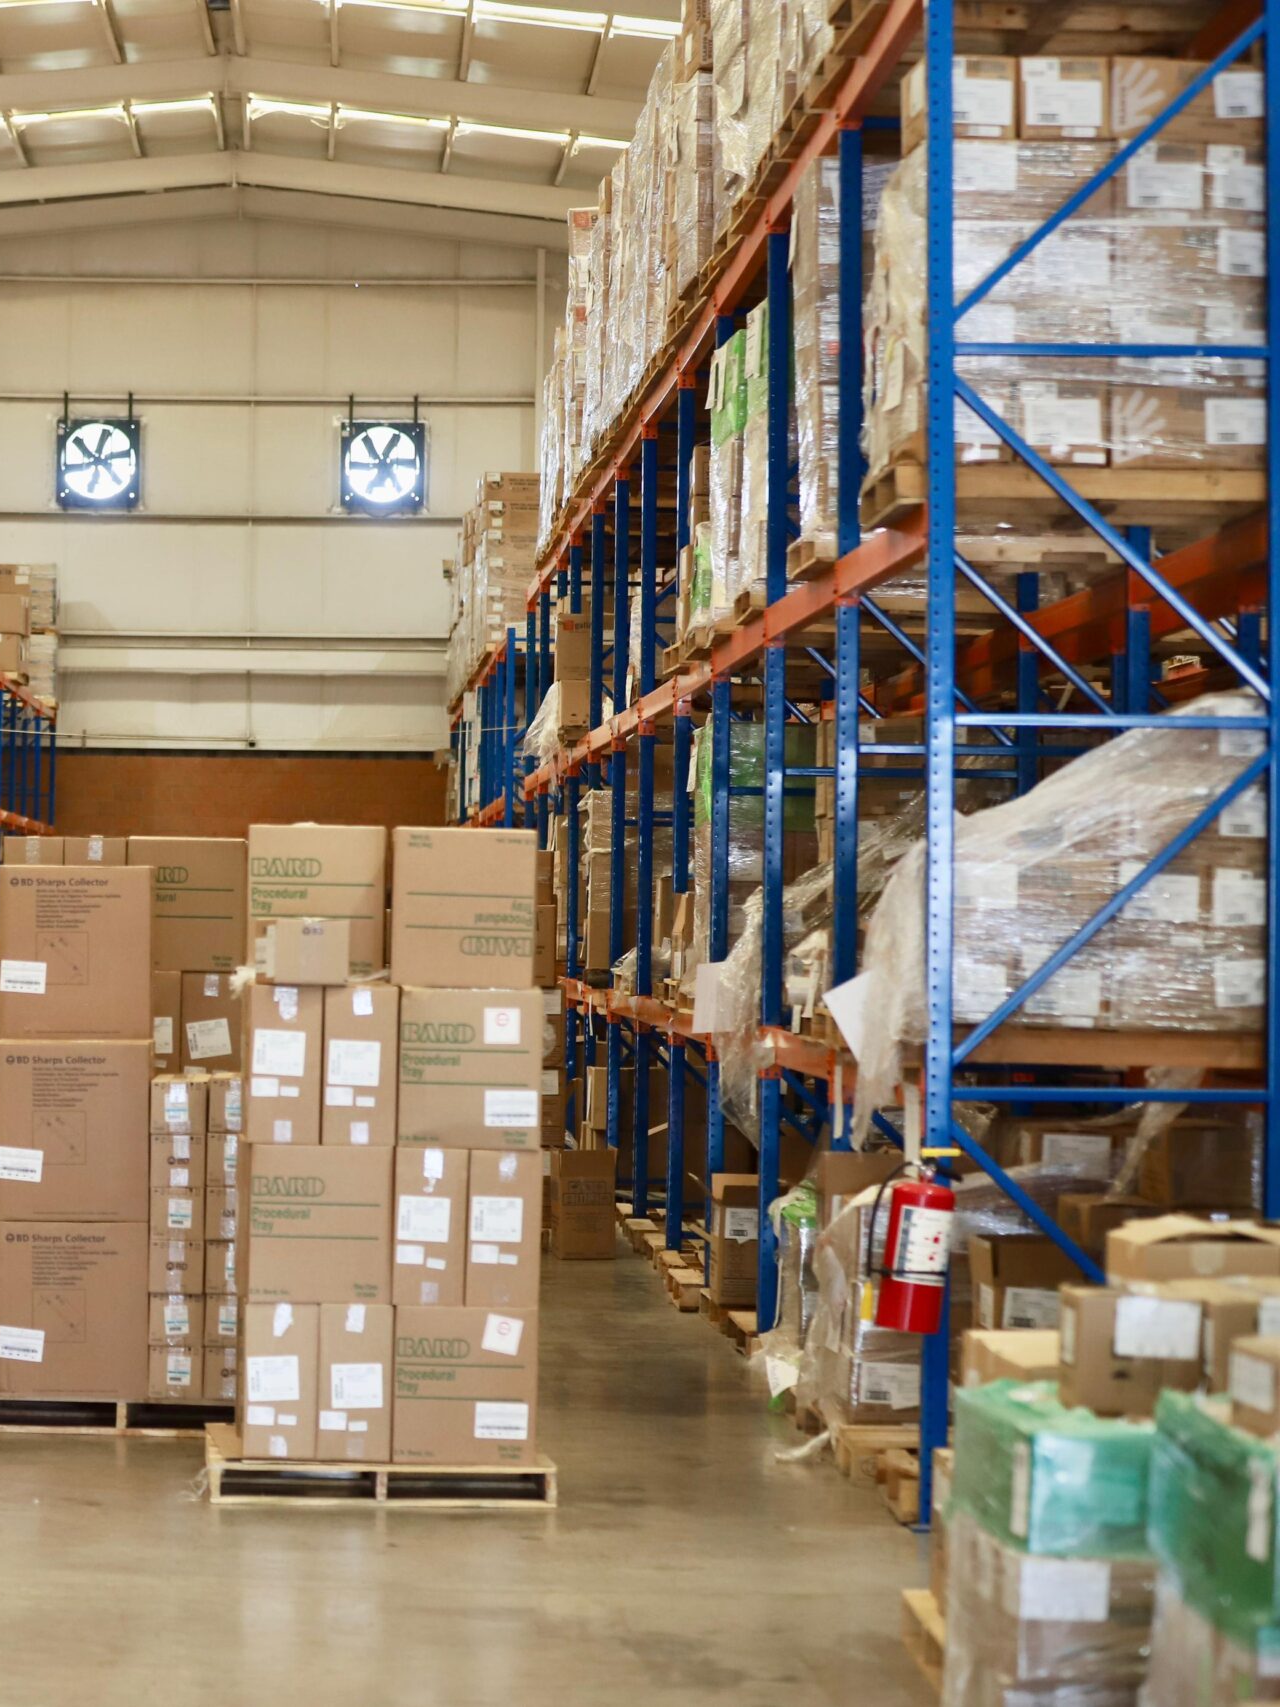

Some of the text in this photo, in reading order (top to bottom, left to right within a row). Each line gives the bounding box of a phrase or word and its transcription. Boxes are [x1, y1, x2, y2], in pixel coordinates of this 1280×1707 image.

[251, 857, 322, 878] BARD
[21, 878, 109, 888] BD Sharps Collector
[251, 887, 307, 900] Procedural
[252, 899, 273, 912] Tray
[460, 936, 534, 957] BARD
[401, 1022, 476, 1044] BARD
[16, 1056, 106, 1066] BD Sharps Collector
[251, 1176, 325, 1197] BARD
[252, 1207, 311, 1220] Procedural
[252, 1219, 273, 1233] Tray
[17, 1234, 106, 1243] BD Sharps Collector
[397, 1337, 470, 1359] BARD
[397, 1368, 456, 1381] Procedural
[397, 1380, 418, 1394] Tray
